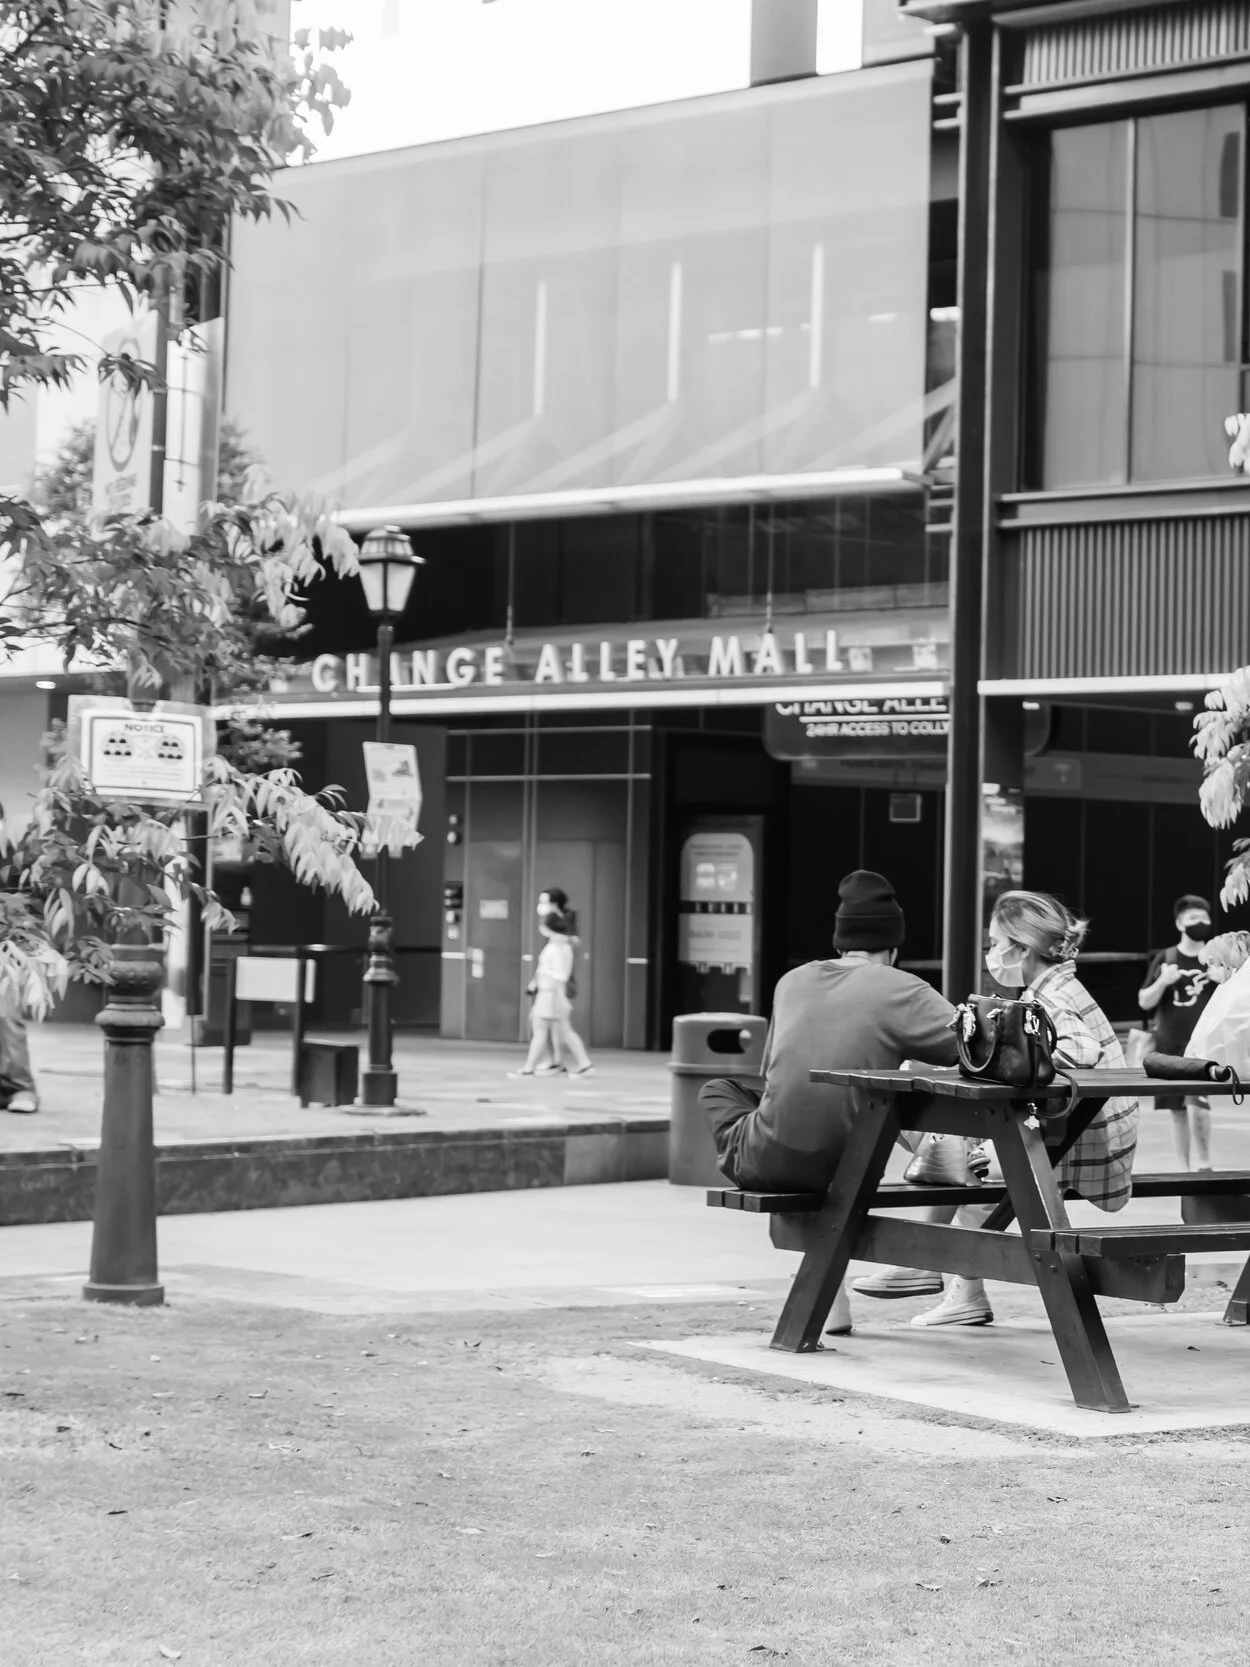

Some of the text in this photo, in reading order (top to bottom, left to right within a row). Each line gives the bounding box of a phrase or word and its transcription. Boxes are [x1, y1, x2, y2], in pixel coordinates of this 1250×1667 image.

[534, 638, 679, 684] ALLEY
[708, 630, 842, 677] MALL
[840, 722, 890, 736] ACCESS
[891, 721, 909, 735] TO
